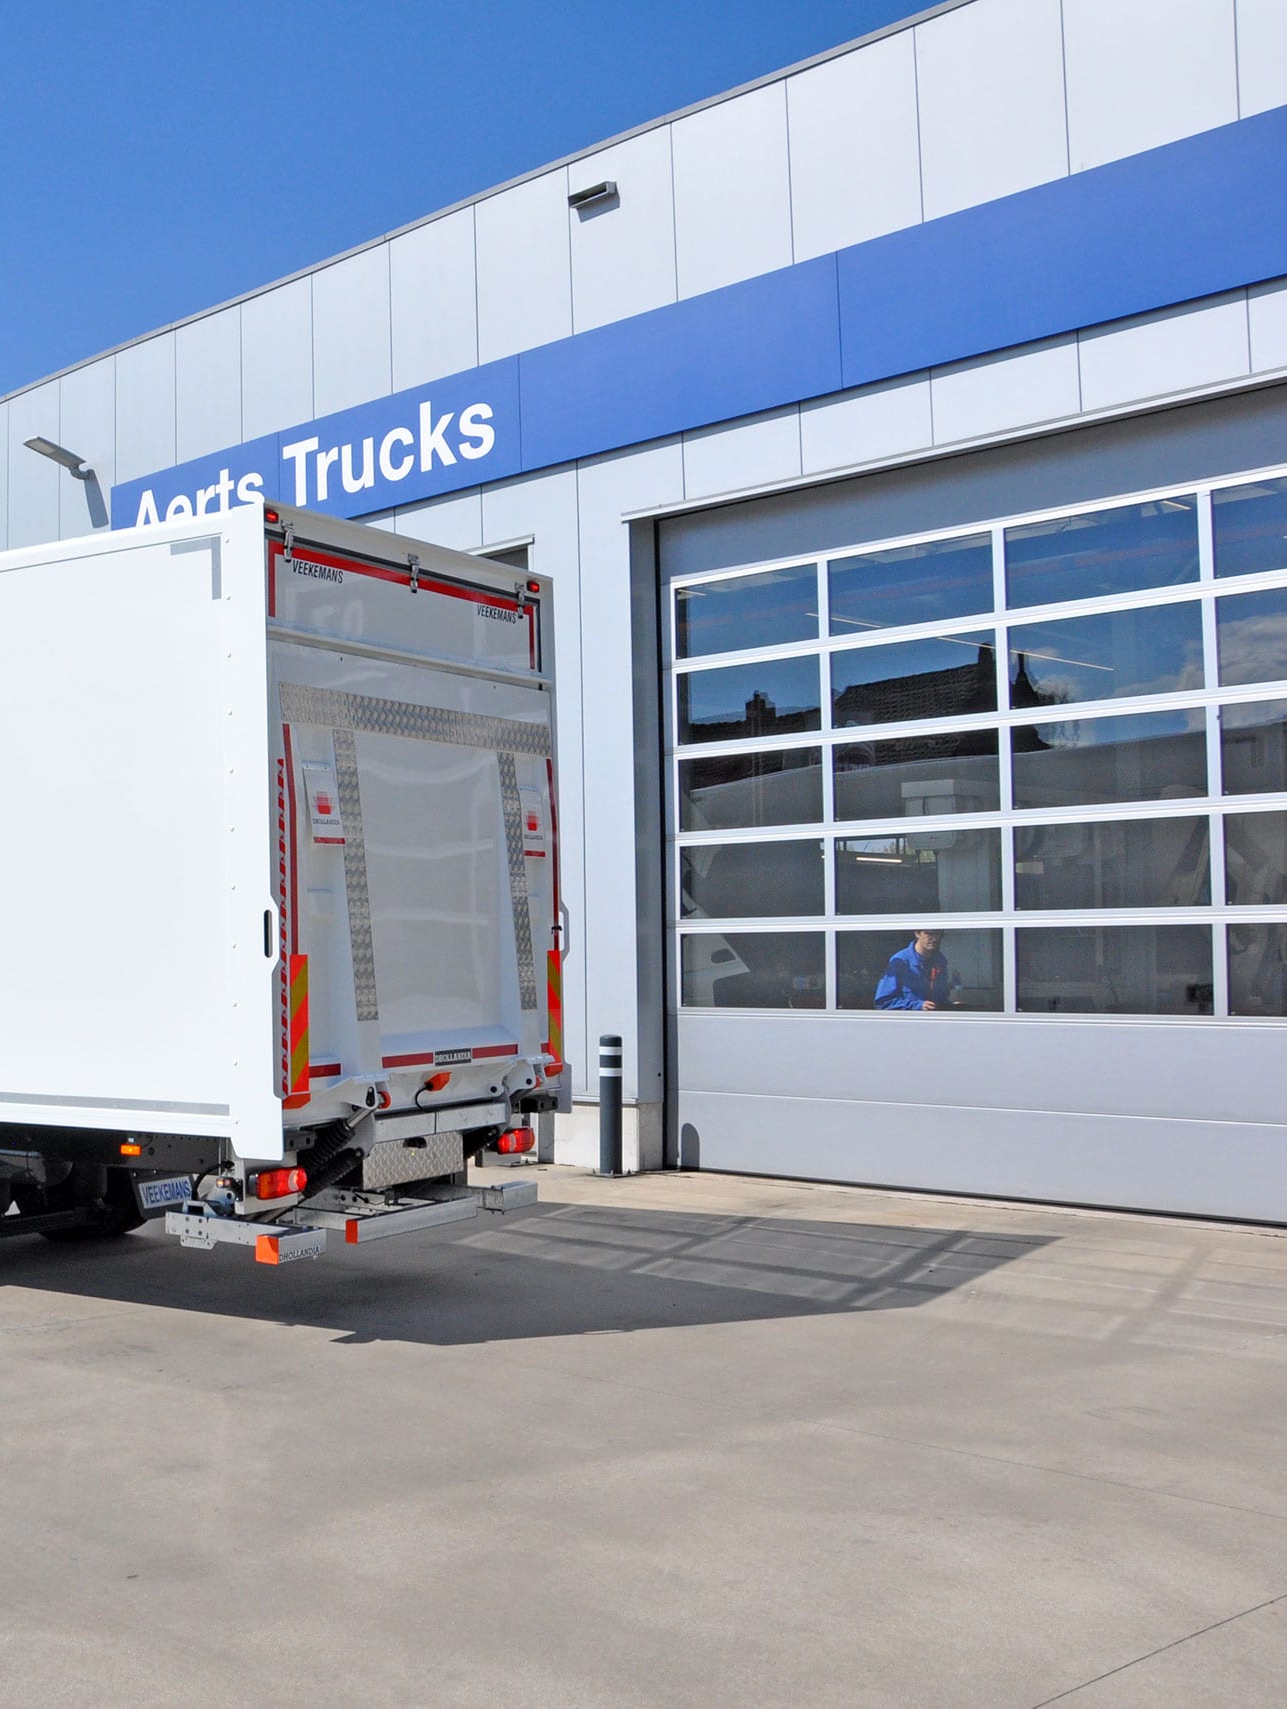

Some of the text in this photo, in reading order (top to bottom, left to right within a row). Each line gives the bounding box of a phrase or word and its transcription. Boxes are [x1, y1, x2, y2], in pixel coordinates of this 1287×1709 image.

[136, 401, 495, 527] Aerts Trucks
[293, 560, 343, 583] VEEKEMANS
[477, 604, 516, 624] VEEKEMANS
[141, 1181, 190, 1204] VEEKEMANS
[279, 1246, 319, 1260] DHOLLANDIA
